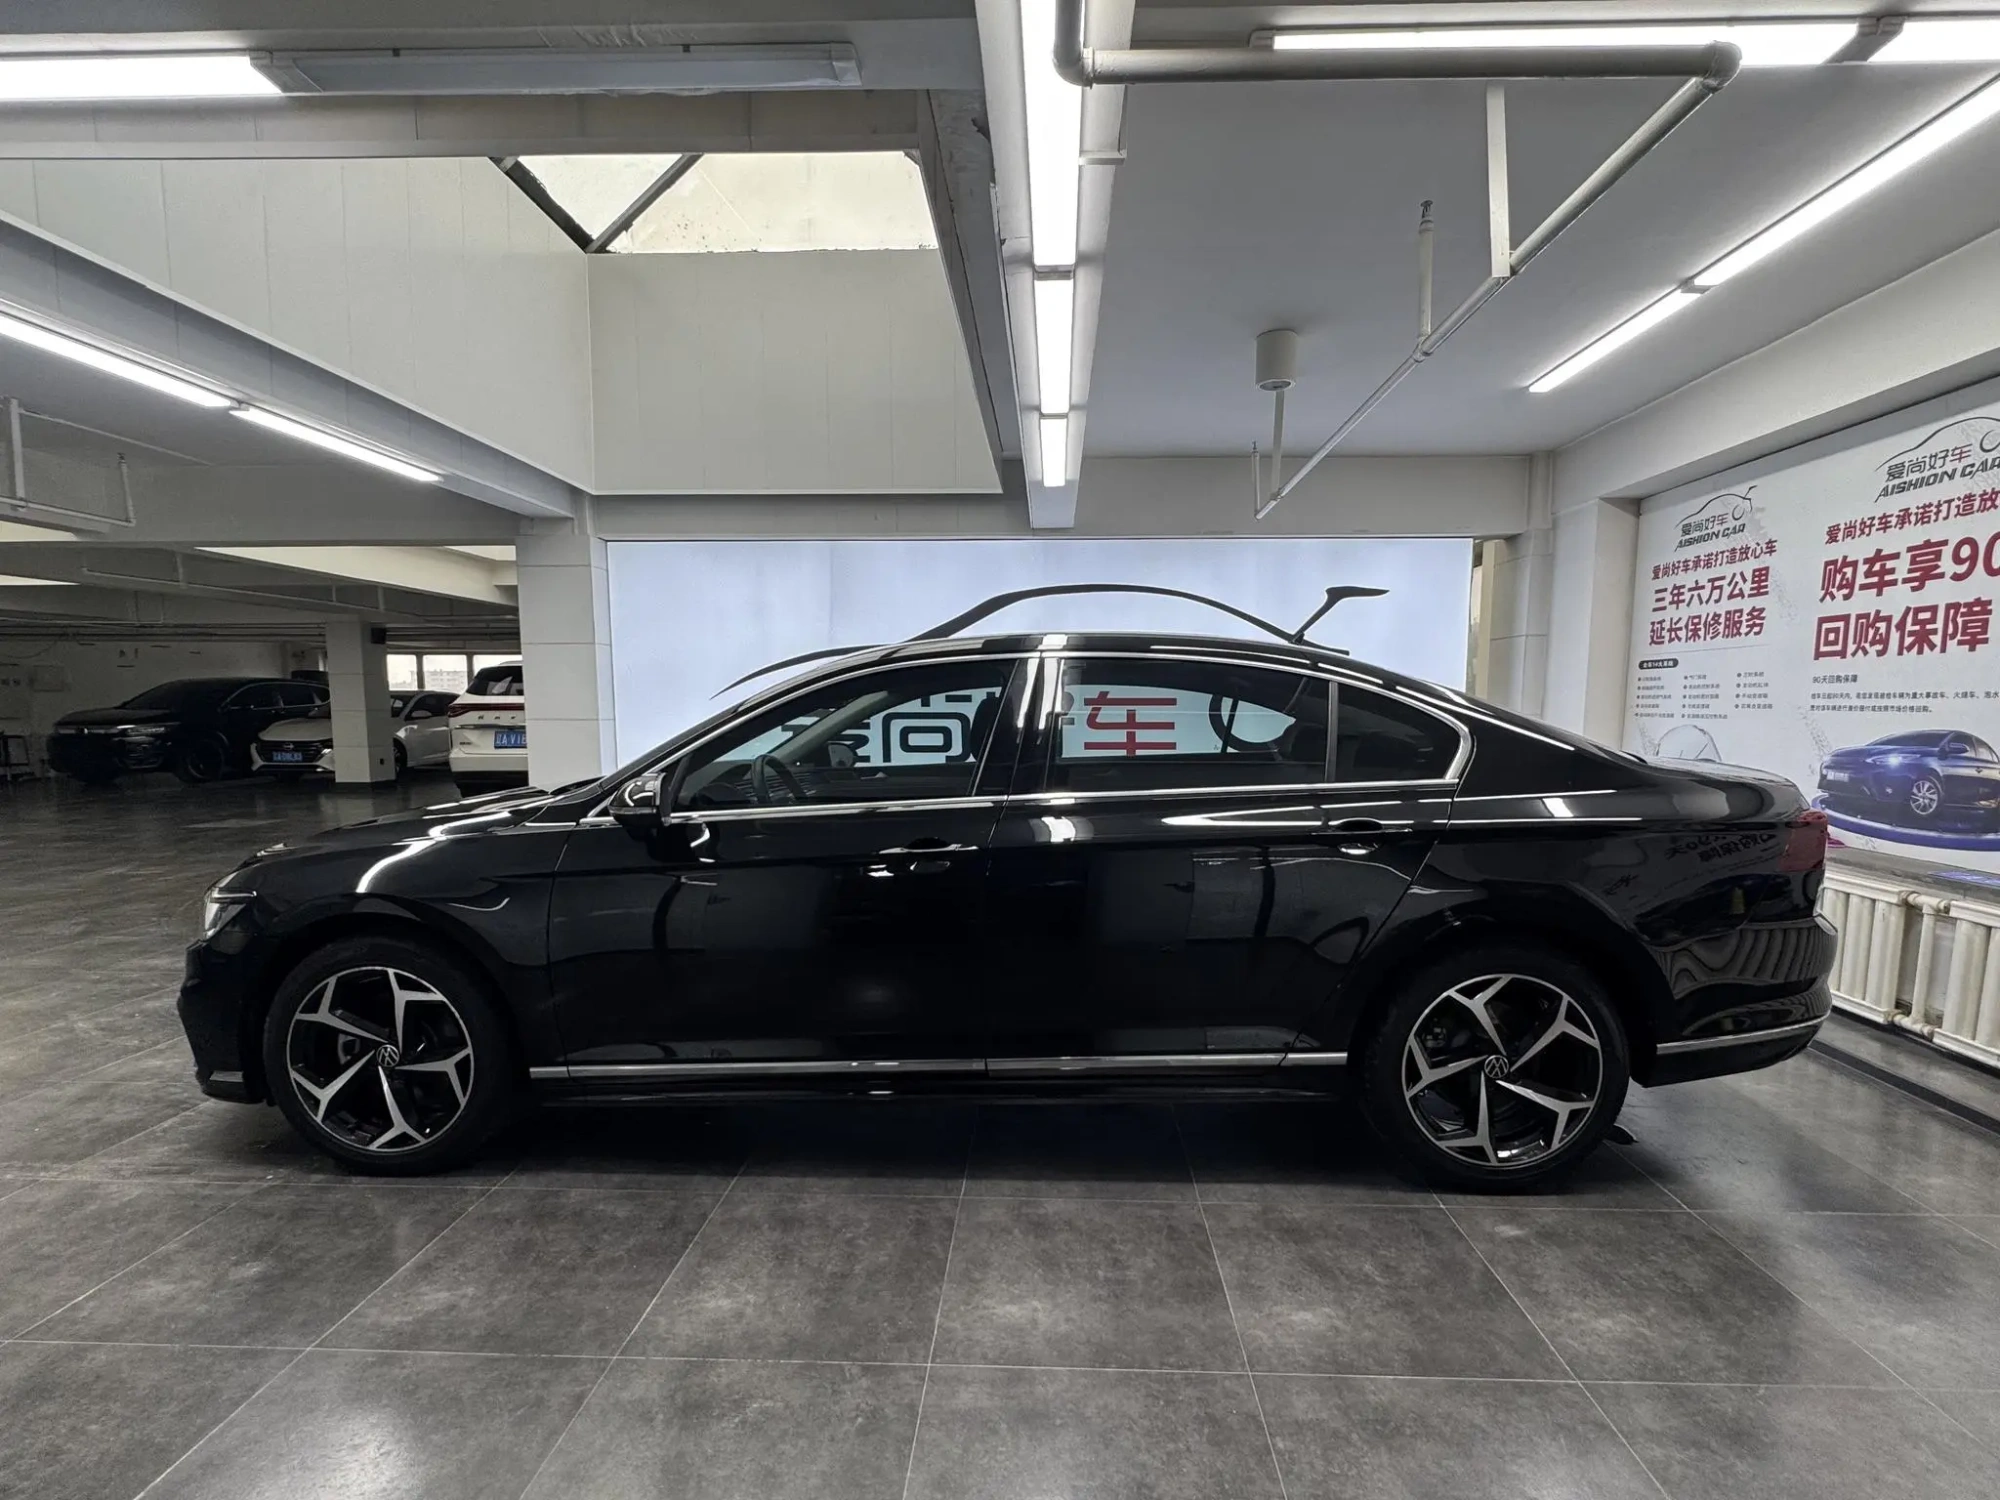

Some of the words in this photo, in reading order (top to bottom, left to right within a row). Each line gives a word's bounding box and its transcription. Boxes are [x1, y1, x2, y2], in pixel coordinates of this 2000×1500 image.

[1885, 443, 1973, 482] 爱尚好车
[1874, 467, 1958, 503] AISHION
[1681, 512, 1730, 538] 爱尚好车
[1825, 486, 2000, 545] 爱尚好车承诺打造放
[1674, 529, 1721, 553] AISHION
[1722, 522, 1746, 540] CAR
[1652, 537, 1778, 580] 爱尚好车承诺打造放心车
[1652, 566, 1770, 612] 三年六万公里
[1649, 605, 1766, 646] 延长保修服务
[1813, 596, 1993, 661] 回购保障
